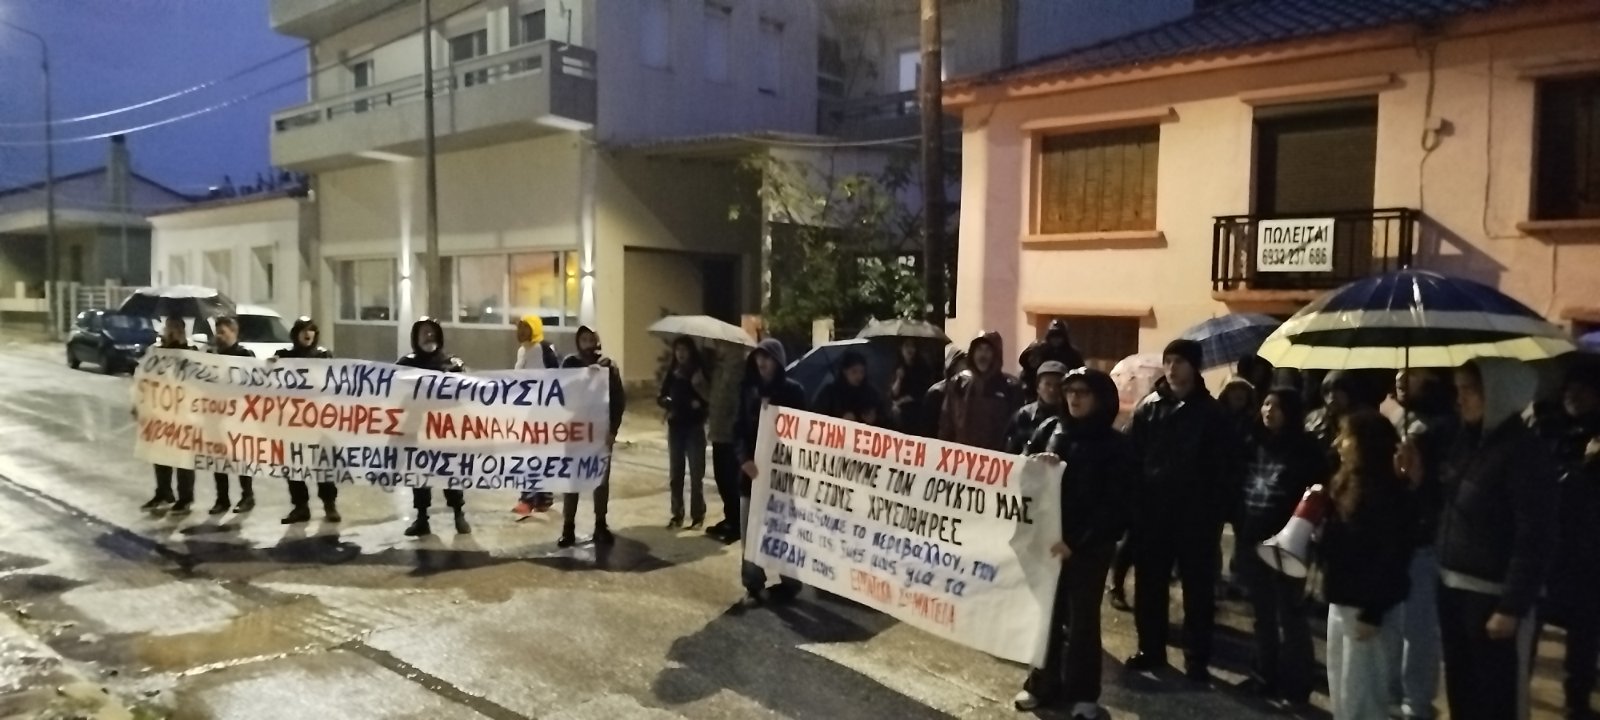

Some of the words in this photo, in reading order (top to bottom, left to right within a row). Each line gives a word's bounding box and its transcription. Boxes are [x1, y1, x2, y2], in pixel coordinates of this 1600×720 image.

[1262, 248, 1285, 265] 6932
[1308, 247, 1327, 265] 686
[1263, 225, 1329, 244] ΠΩΛΕΙΤΑΙ
[413, 374, 565, 407] ΠΕΡΙΟΥΣΙΑ
[240, 393, 404, 436] ΧΡΥΣΟΘΗΡΕΣ
[426, 411, 456, 440] ΝΑ
[460, 413, 593, 445] ΑΝΑΚΛΗΘΕΙ
[227, 431, 285, 465] ΥΠΕΝ
[290, 441, 303, 465] Η
[403, 446, 458, 477] ΤΟΥΣ
[775, 412, 800, 441] ΟΧΙ
[806, 419, 847, 450] ΣΤΗΝ
[853, 428, 927, 468] ΕΞΟΡΥΞΗ
[936, 446, 1014, 488] ΧΡΥΣΟΥ
[771, 441, 793, 467] ΔΕΝ
[886, 466, 917, 498] ΤΟΝ
[923, 476, 986, 515] ΟΡΥΚΤΟ
[995, 491, 1034, 525] ΜΑΣ
[867, 493, 963, 546] ΧΡΥΣΟΘΗΡΕΣ
